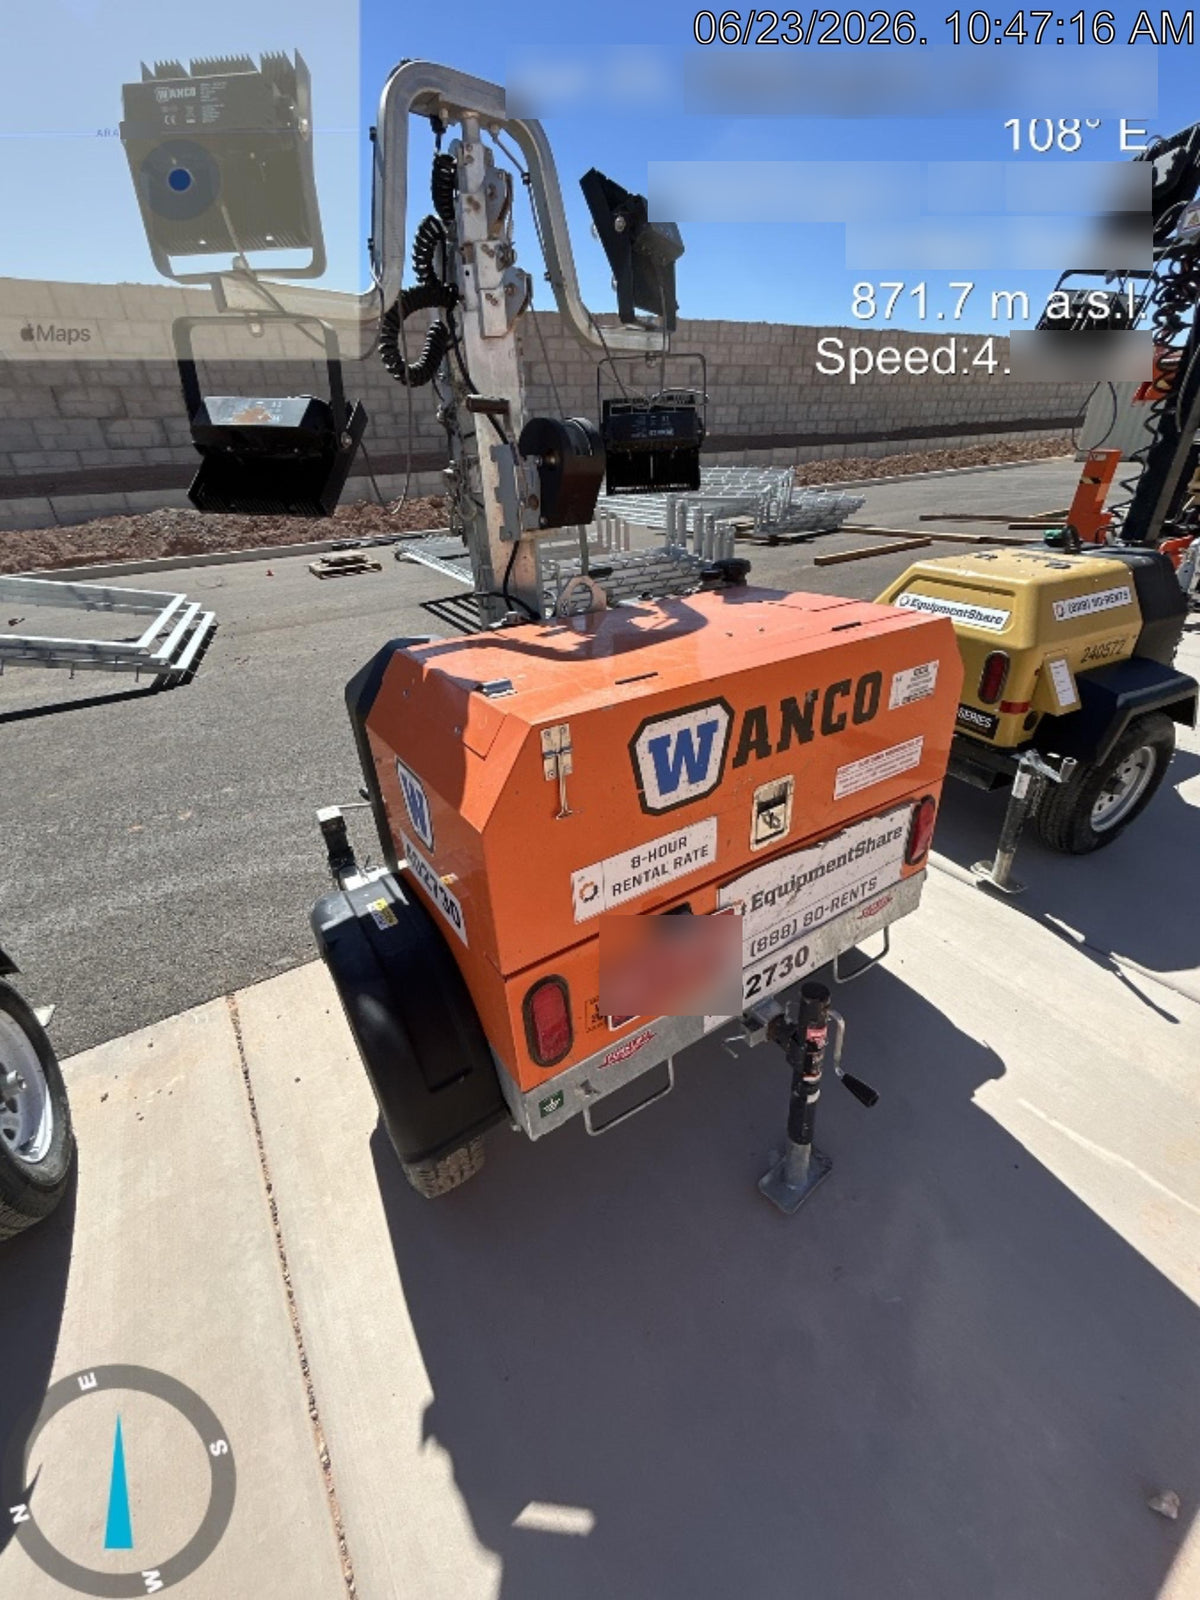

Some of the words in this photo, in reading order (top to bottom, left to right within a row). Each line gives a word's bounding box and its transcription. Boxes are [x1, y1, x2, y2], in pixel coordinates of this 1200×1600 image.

[909, 597, 1004, 626] EquipmentShare
[638, 670, 882, 806] WANCO
[399, 767, 431, 845] W
[612, 863, 669, 897] RENTAL
[673, 844, 709, 870] RATE
[630, 836, 688, 869] 8-HOUR
[751, 826, 903, 912] EquipmentShare
[751, 919, 798, 957] (888)
[802, 876, 878, 928] 80-RENTS
[745, 945, 809, 1000] 2730
